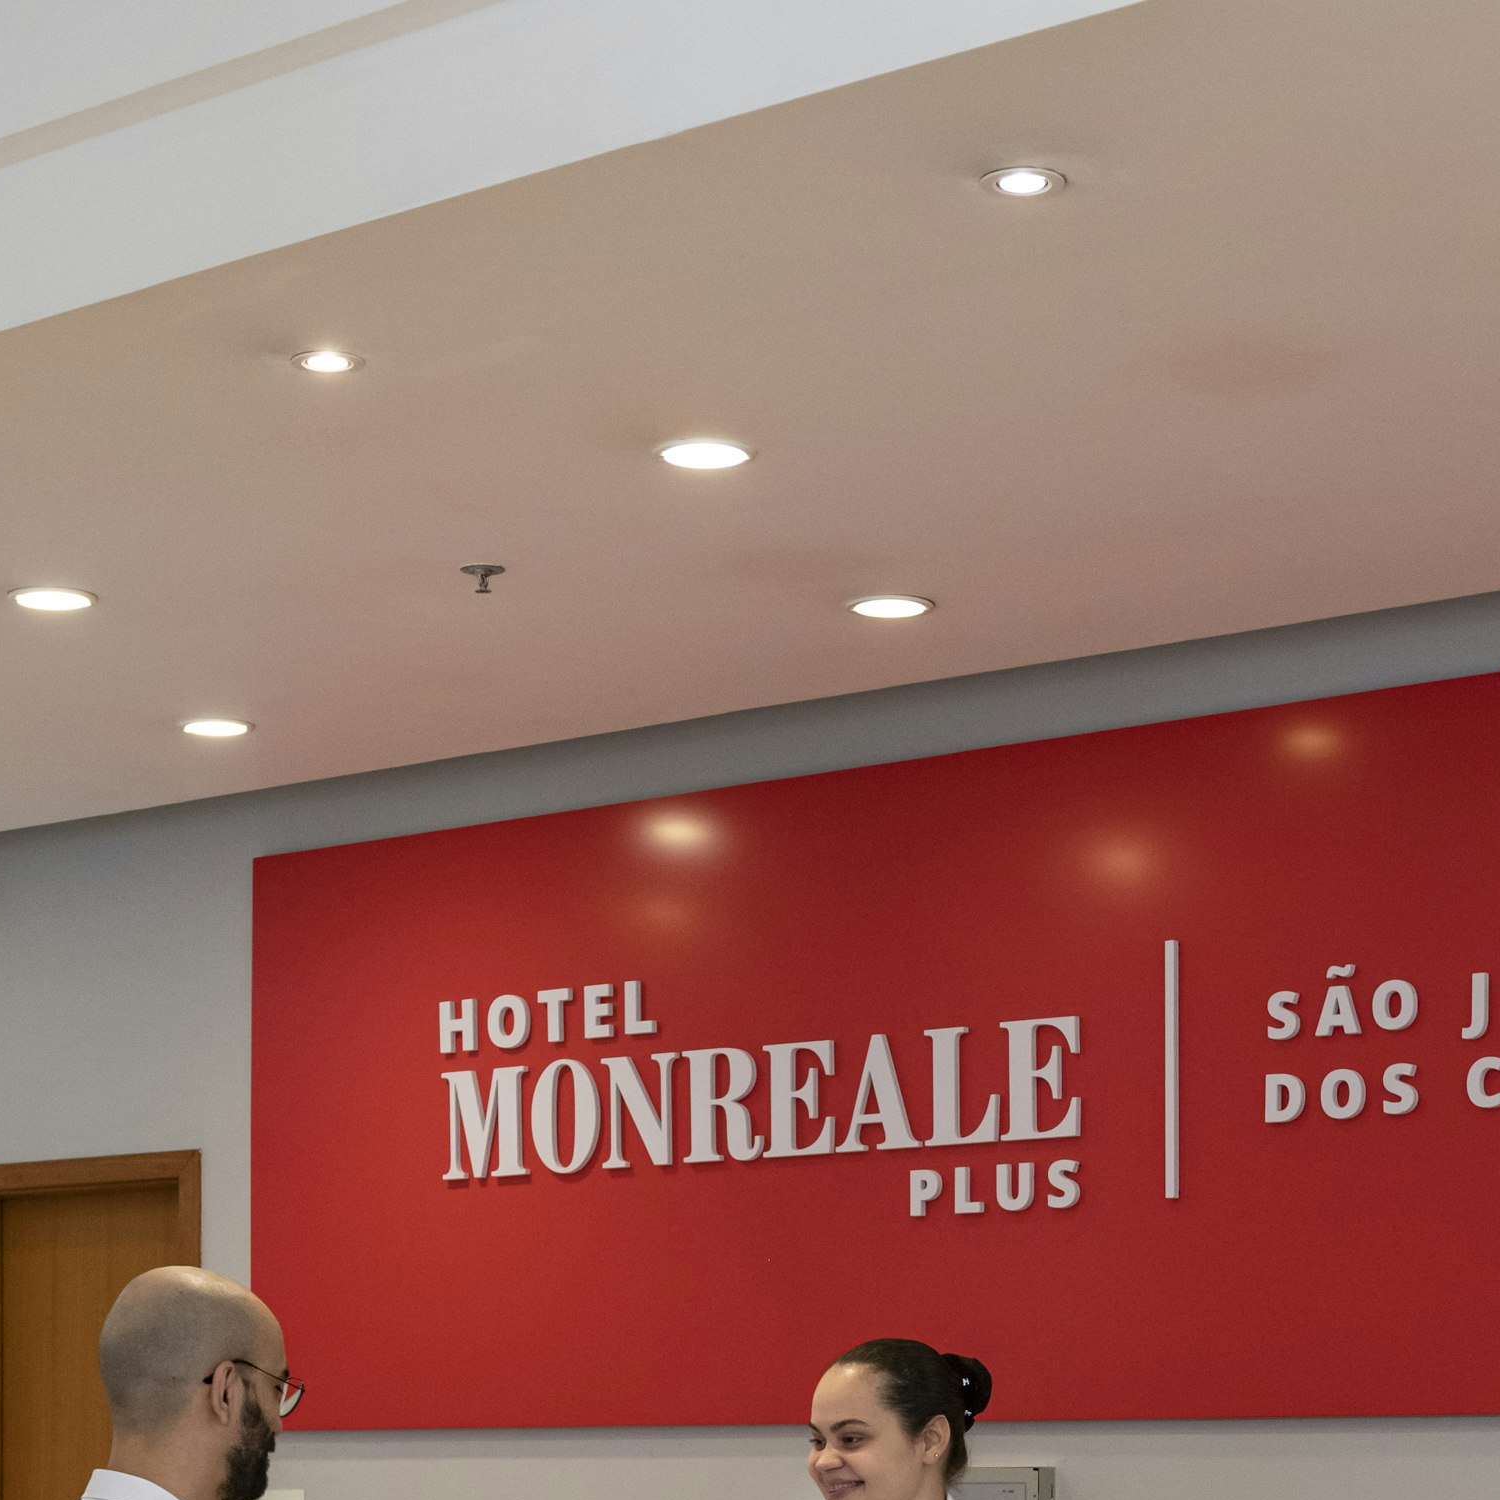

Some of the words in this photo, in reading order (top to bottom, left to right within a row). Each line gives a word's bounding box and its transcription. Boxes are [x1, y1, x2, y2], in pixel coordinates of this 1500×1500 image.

[436, 979, 660, 1056] HOTEL
[1266, 962, 1419, 1041] SÃO
[439, 1014, 1083, 1184] MONREALE
[1263, 1061, 1420, 1124] DOS
[908, 1158, 1082, 1218] PLUS
